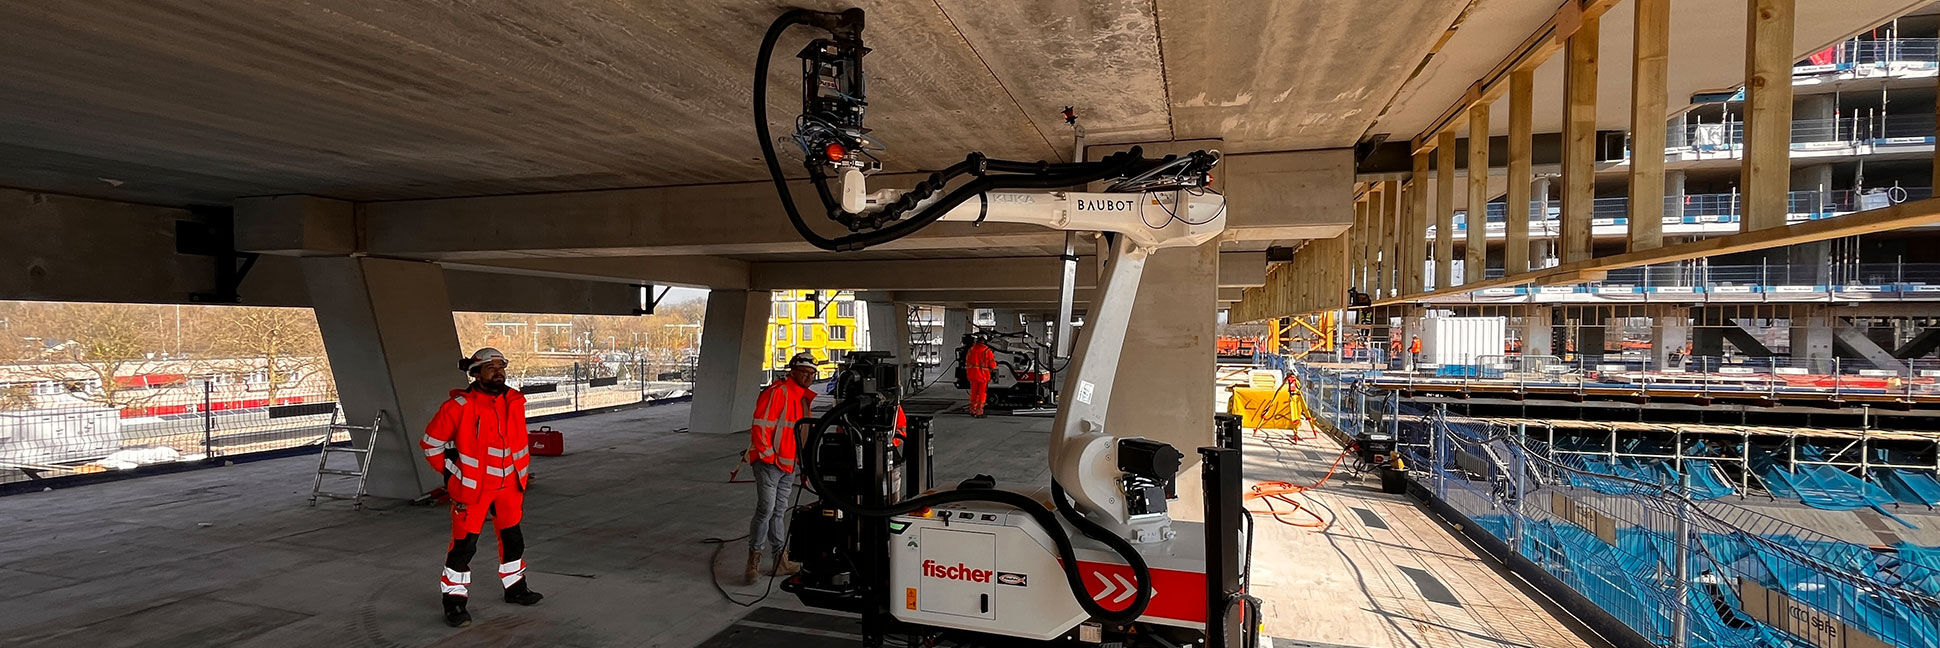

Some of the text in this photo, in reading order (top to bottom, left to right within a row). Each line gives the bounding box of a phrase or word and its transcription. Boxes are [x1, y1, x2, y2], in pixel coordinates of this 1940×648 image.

[992, 194, 1035, 204] KUKA
[1077, 199, 1134, 211] BAUBOT
[922, 559, 993, 583] fischer
[1811, 615, 1837, 638] safe
